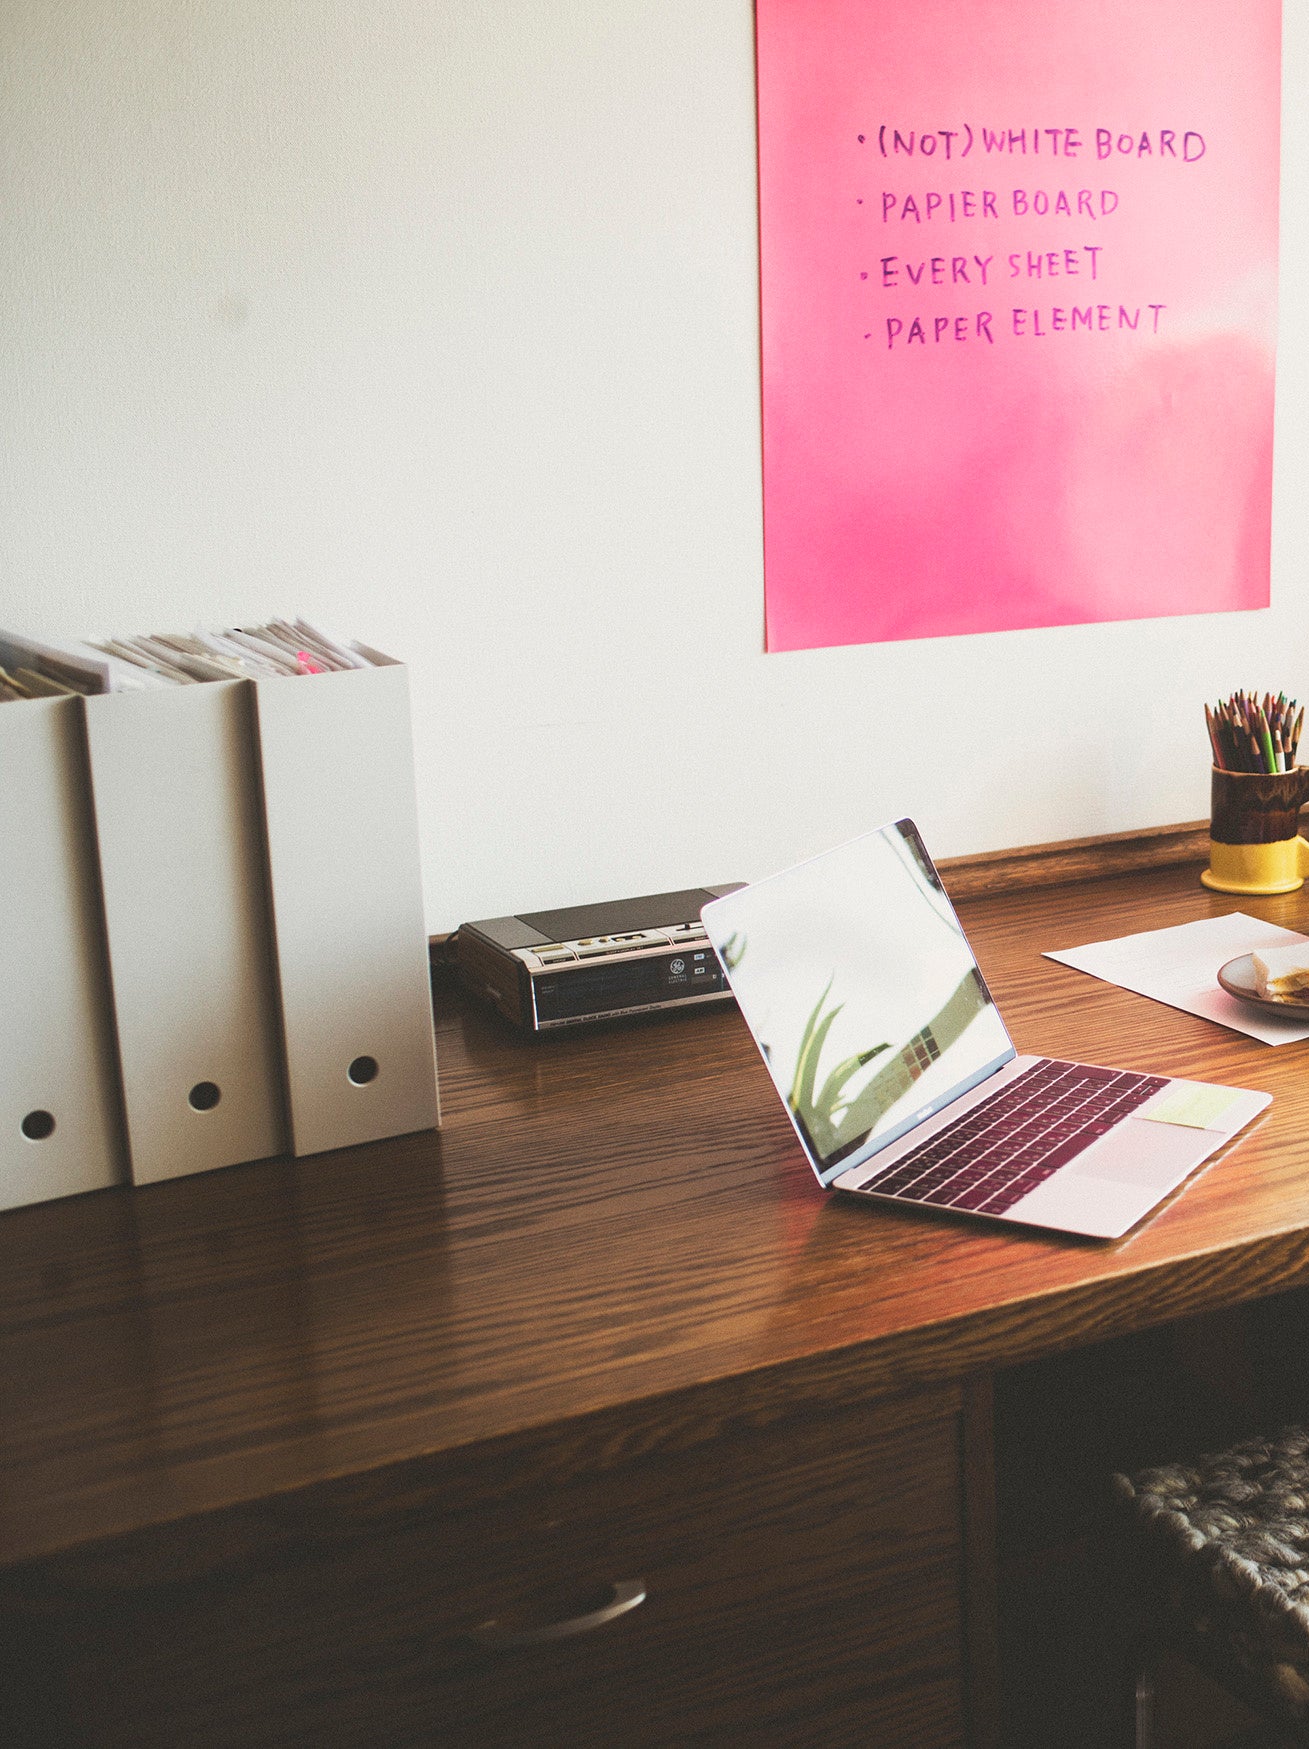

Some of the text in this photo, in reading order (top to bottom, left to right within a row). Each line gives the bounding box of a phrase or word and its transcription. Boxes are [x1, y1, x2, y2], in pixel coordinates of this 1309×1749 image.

[1097, 128, 1206, 162] BOARD
[882, 189, 1120, 223] PAPIER BOARD
[880, 246, 1103, 288] EVERY SHEET
[887, 304, 1168, 349] PAPER ELEMENT
